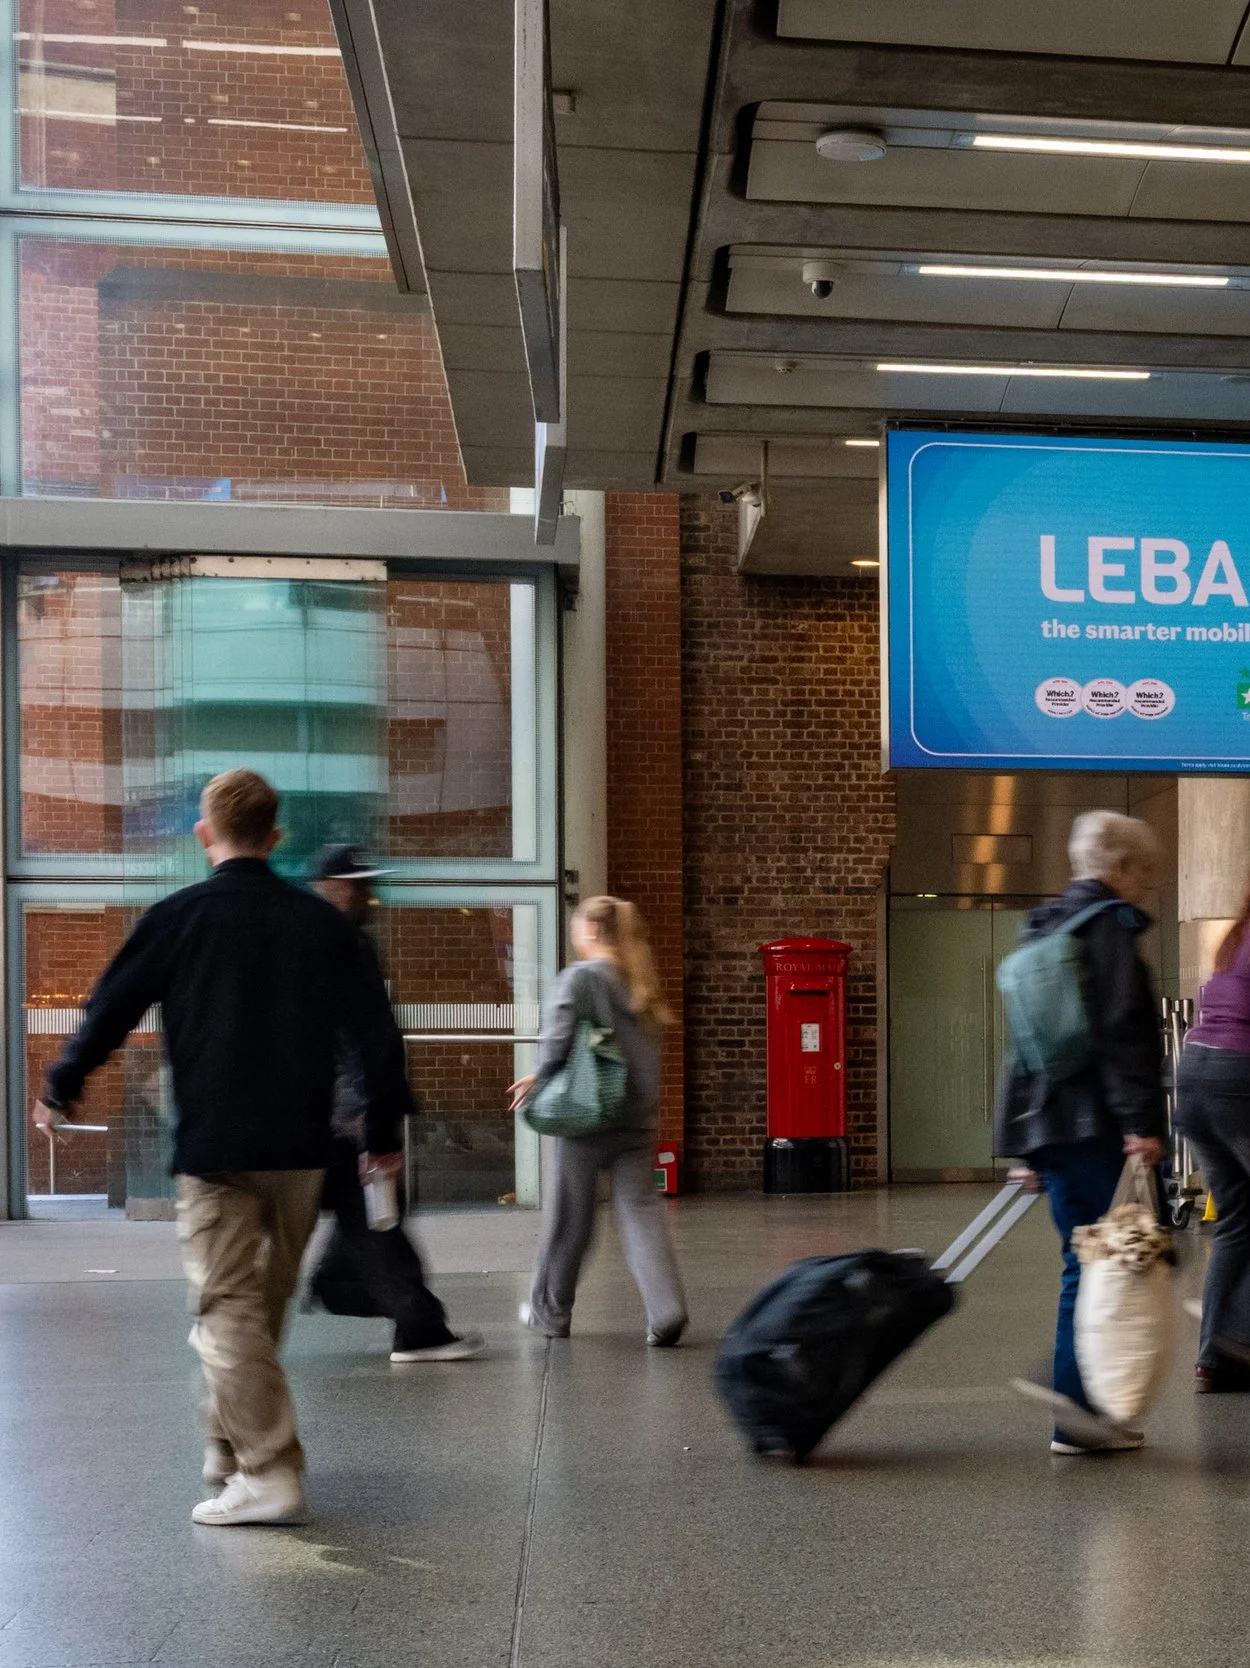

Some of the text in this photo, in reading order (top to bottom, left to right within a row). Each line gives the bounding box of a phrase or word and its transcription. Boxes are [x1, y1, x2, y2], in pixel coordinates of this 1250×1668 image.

[1041, 619, 1080, 639] the
[1085, 621, 1181, 641] smarter
[1046, 690, 1075, 698] Which?
[1091, 690, 1120, 699] Which?
[1135, 691, 1164, 700] Which?
[775, 962, 811, 972] ROYAL
